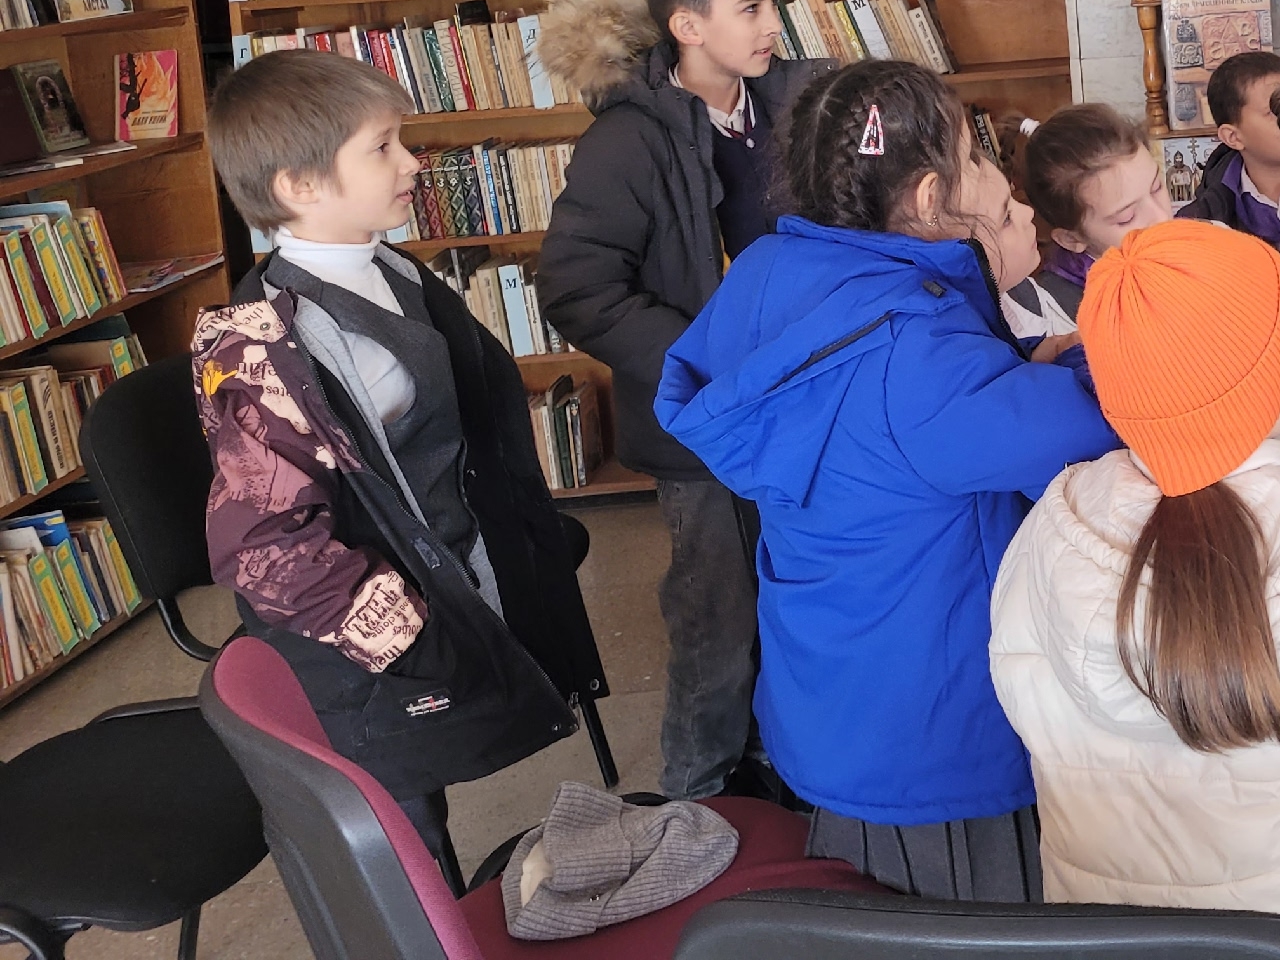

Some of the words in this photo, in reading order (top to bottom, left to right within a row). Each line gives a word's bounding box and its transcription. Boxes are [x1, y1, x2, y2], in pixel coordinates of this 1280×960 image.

[241, 48, 247, 58] Г
[437, 178, 445, 188] 3
[505, 279, 517, 289] М
